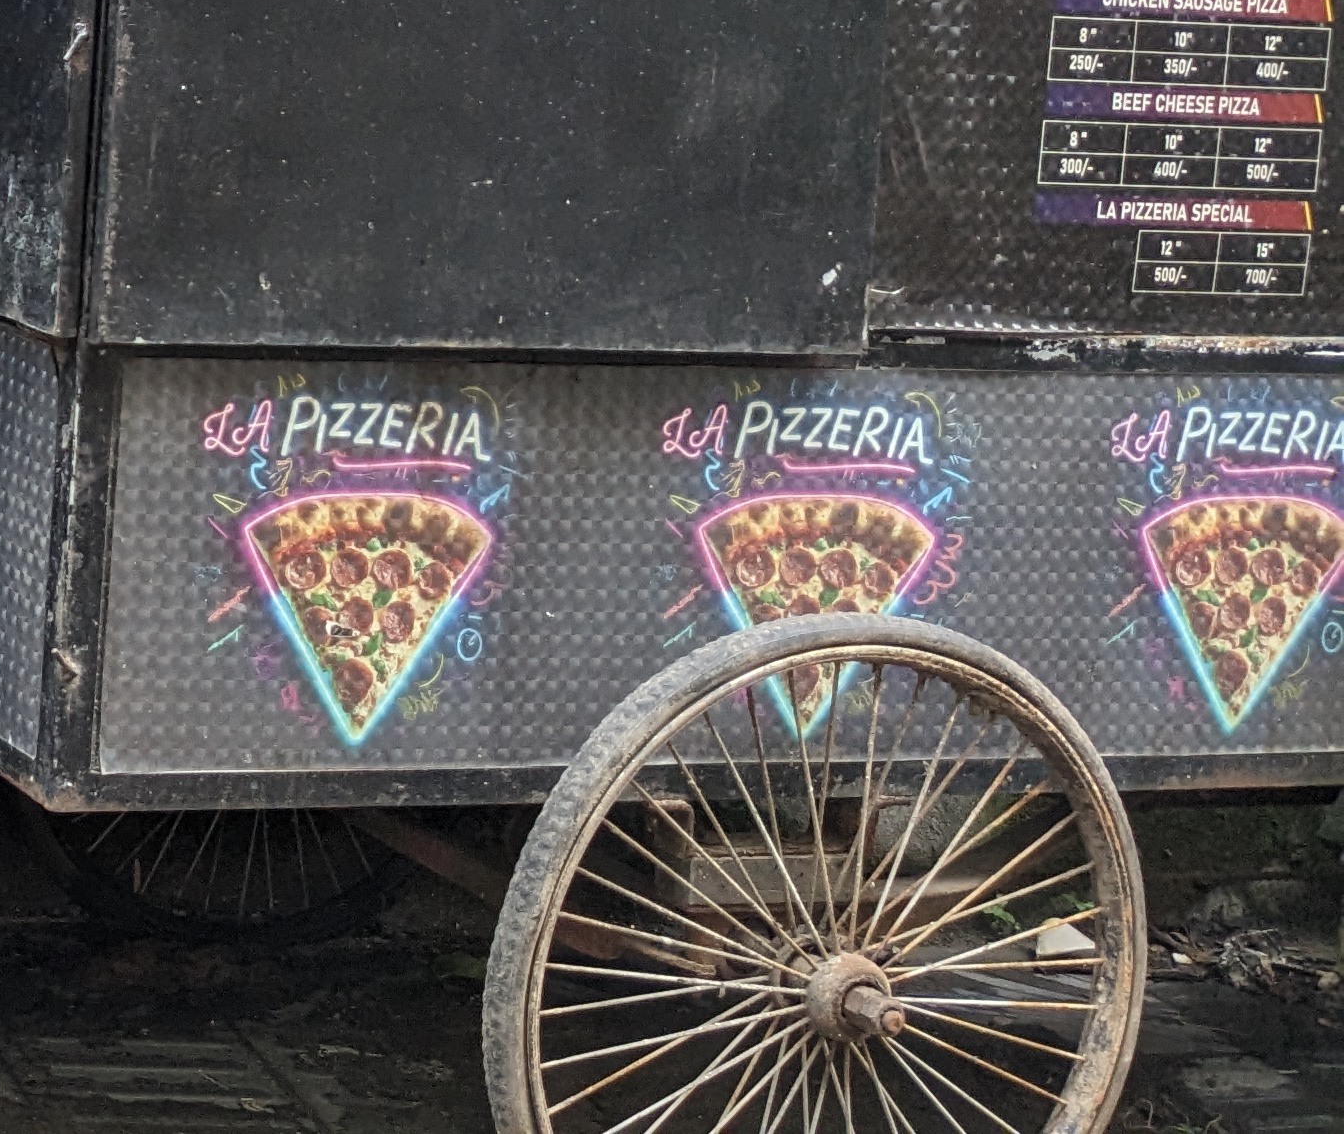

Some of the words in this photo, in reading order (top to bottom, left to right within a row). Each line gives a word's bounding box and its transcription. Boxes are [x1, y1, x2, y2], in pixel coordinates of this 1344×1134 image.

[1112, 92, 1151, 112] BEEF
[1155, 94, 1215, 114] CHEESE
[1218, 97, 1260, 116] PIZZA
[1096, 201, 1117, 220] LA
[1121, 201, 1187, 222] PIZZERIA
[1192, 204, 1253, 224] SPECIAL
[203, 399, 273, 457] LA
[281, 395, 490, 462] PIZZERIA
[662, 403, 729, 458] LA
[734, 400, 933, 464] PIZZERIA
[1111, 409, 1172, 462] LA
